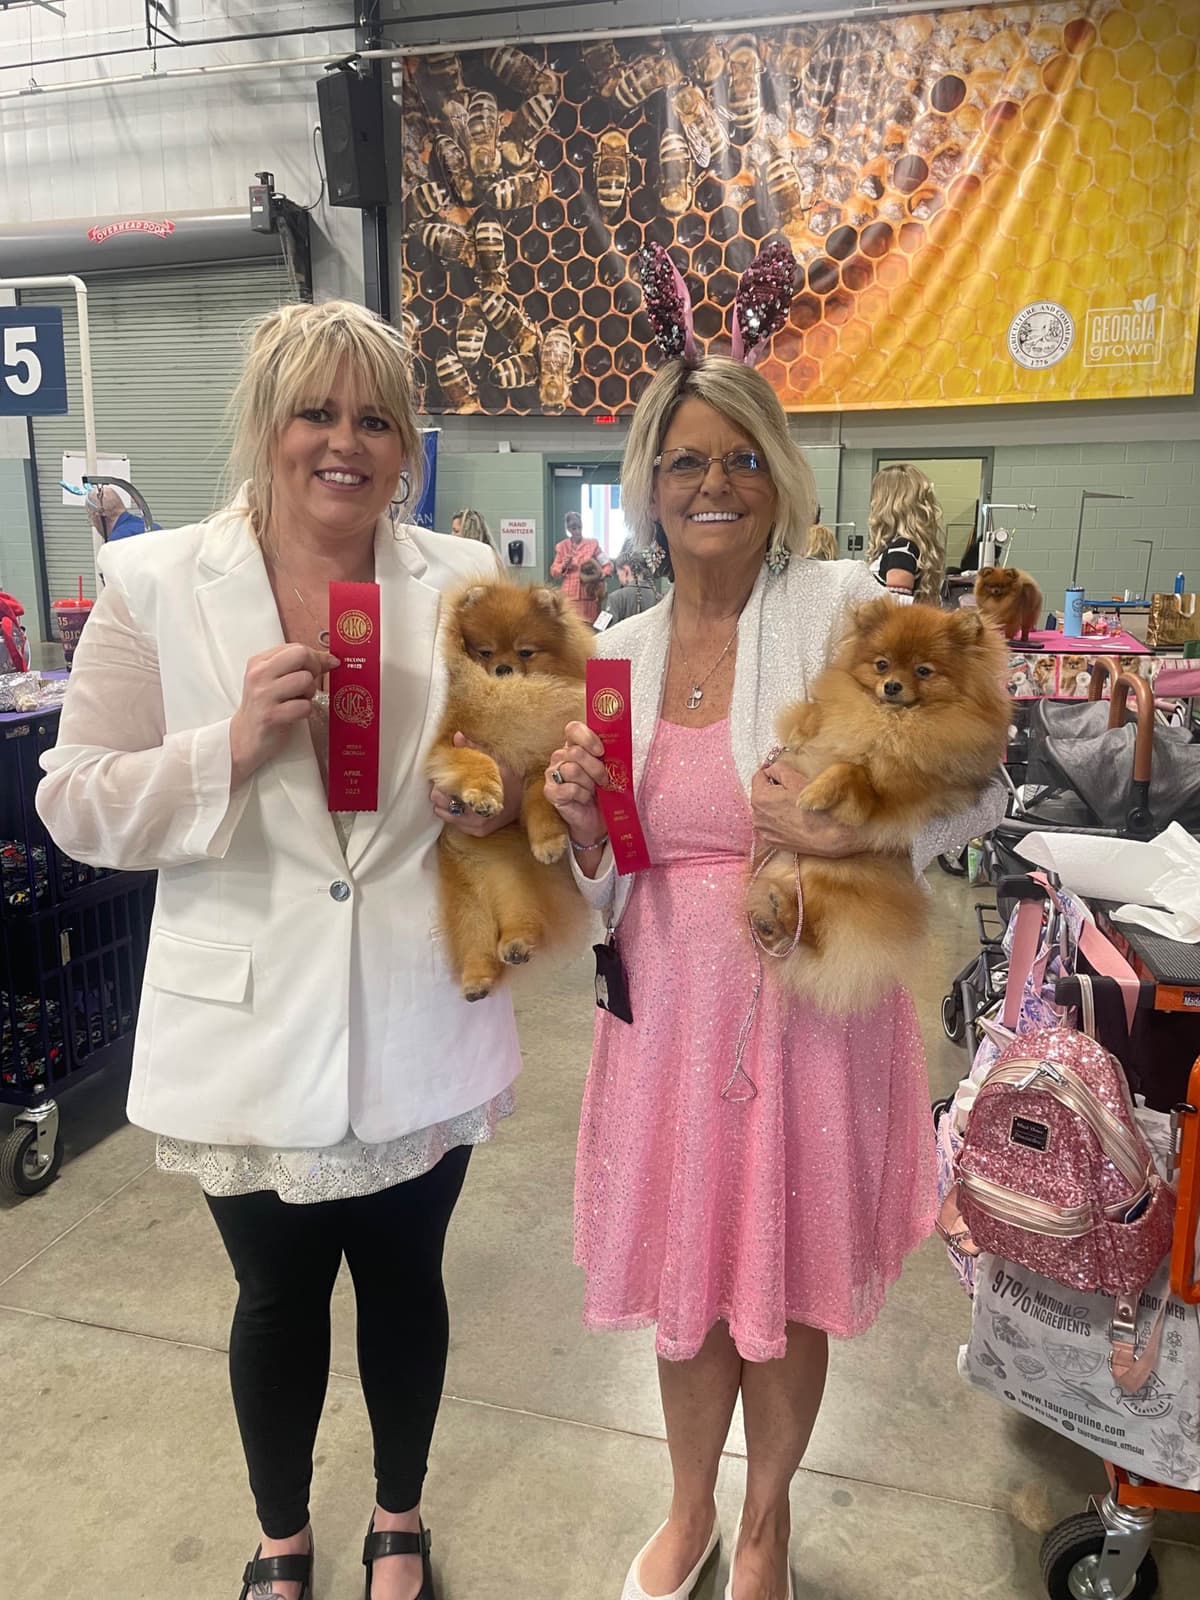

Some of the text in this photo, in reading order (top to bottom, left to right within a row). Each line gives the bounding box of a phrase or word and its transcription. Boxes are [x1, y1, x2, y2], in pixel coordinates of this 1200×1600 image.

[97, 222, 142, 240] OVERHEAD
[1092, 313, 1155, 343] GEORGIA
[3, 325, 42, 396] 5
[1090, 343, 1155, 361] grown
[991, 1269, 1073, 1317] 97% NATURAL
[1139, 1292, 1186, 1321] GROMER
[1029, 1303, 1092, 1337] INGREDIENTS
[1020, 1389, 1126, 1437] www.tauroproline.com
